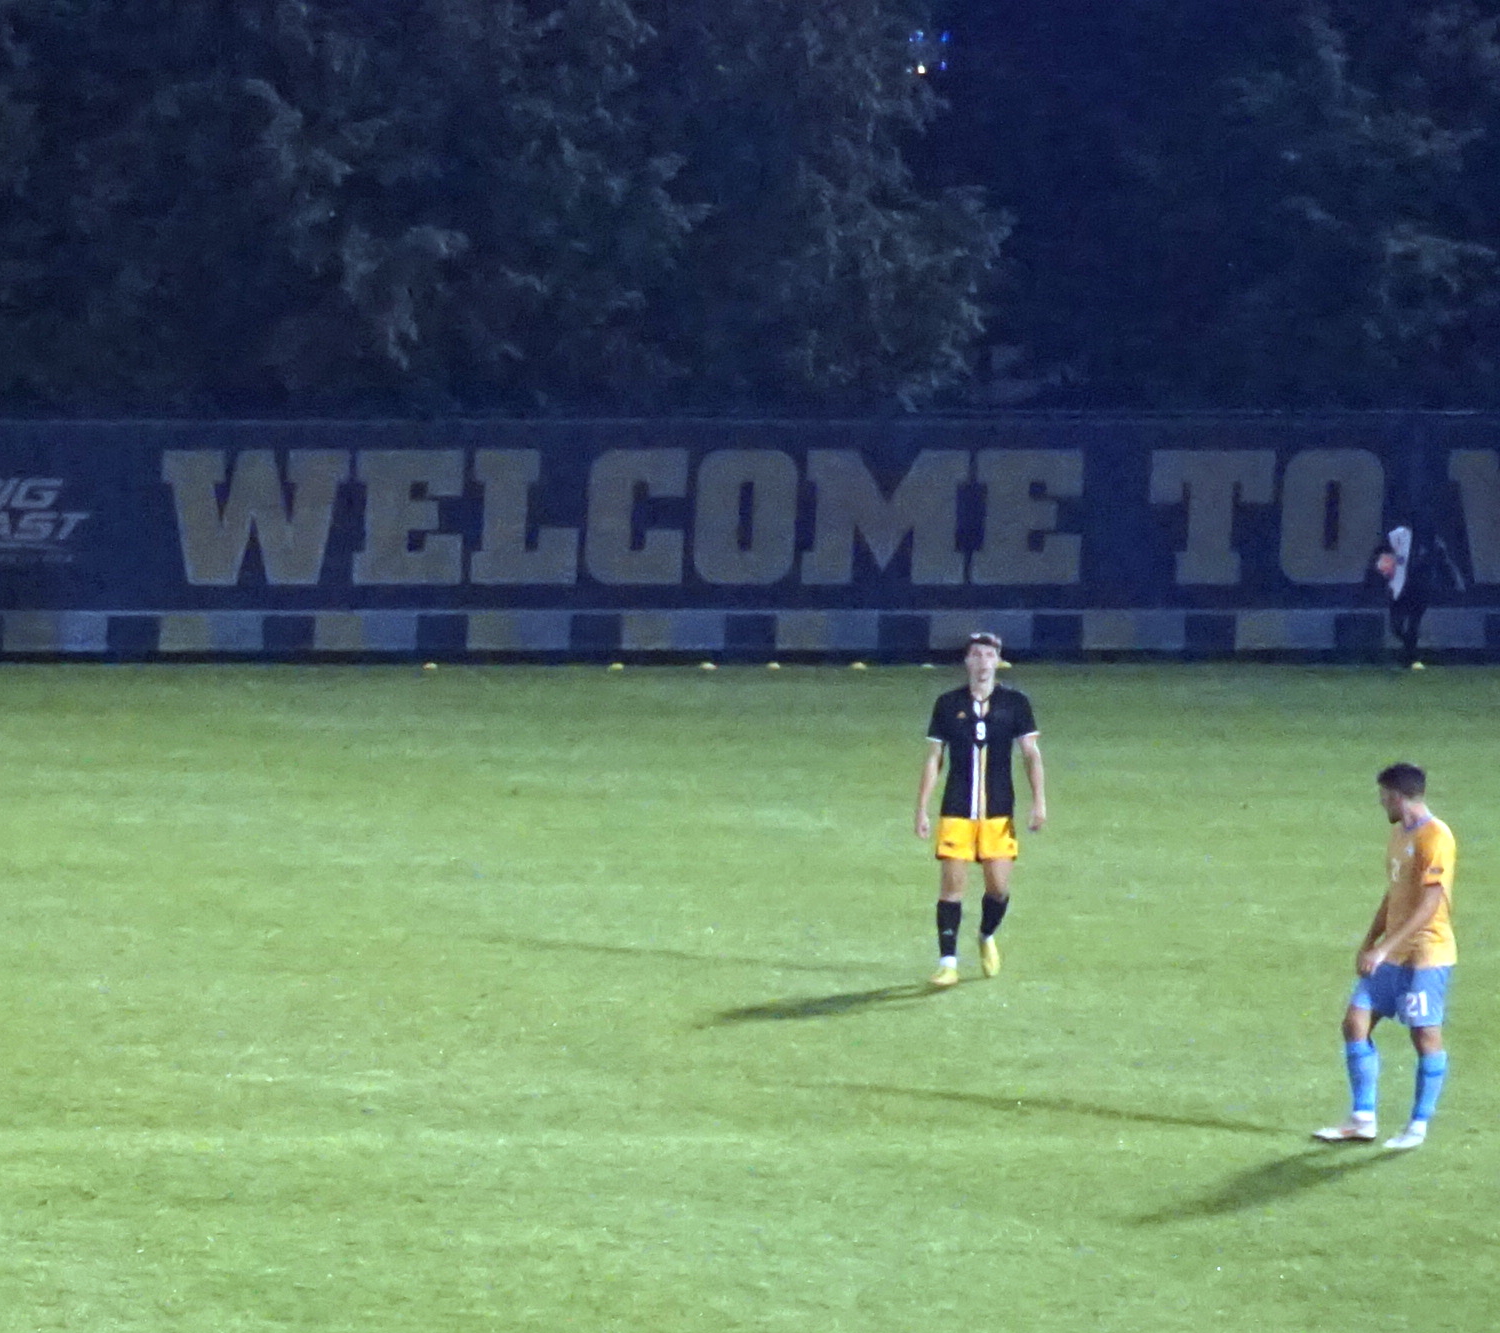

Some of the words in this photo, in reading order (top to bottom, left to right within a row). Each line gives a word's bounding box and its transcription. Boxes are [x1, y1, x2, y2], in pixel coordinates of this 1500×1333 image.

[161, 448, 1085, 587] WELCOME
[1150, 448, 1386, 586] TO
[1405, 990, 1429, 1018] 21
